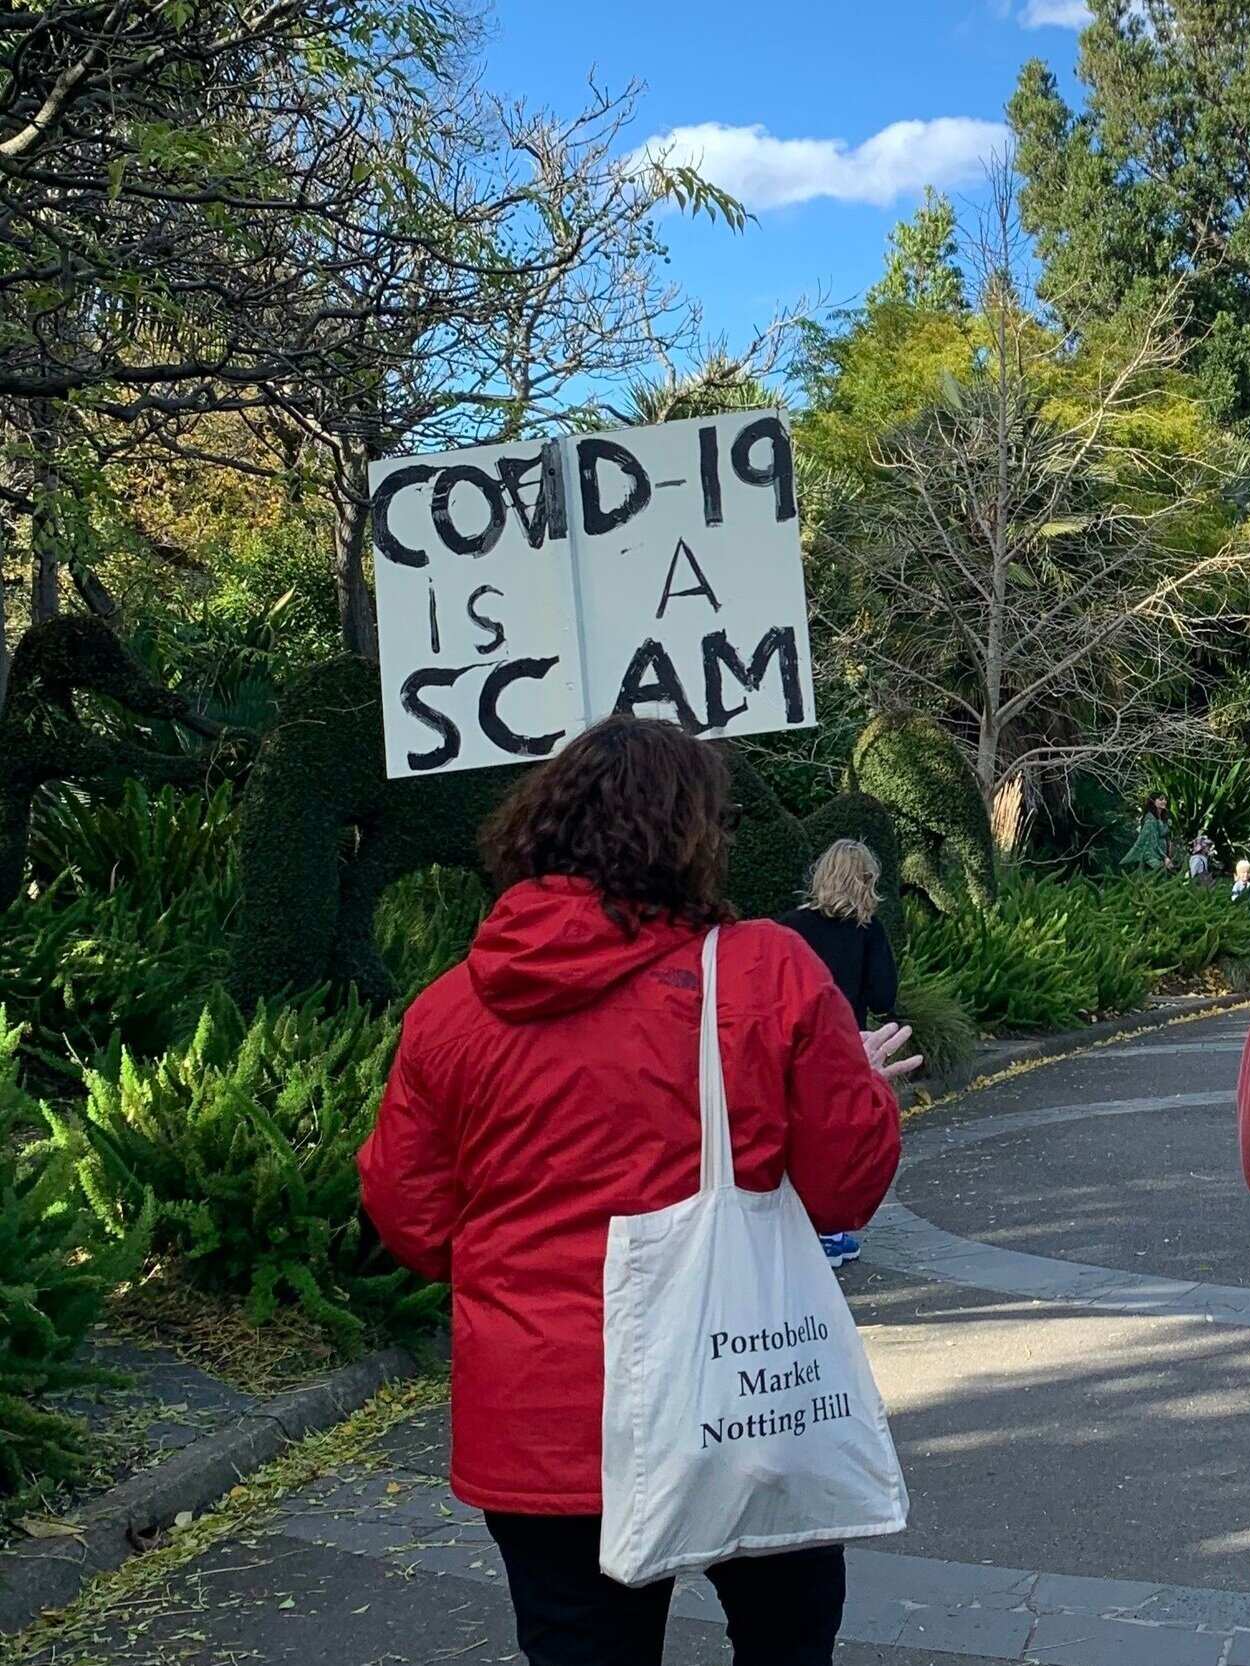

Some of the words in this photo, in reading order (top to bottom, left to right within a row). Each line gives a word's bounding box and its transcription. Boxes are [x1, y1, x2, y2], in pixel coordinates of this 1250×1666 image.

[371, 416, 798, 568] COVID-19
[656, 536, 722, 619] A
[400, 626, 805, 771] SCAM
[710, 1314, 829, 1360] Portobello
[737, 1358, 822, 1397] Market
[700, 1408, 807, 1449] Notting
[811, 1392, 853, 1424] Hill
